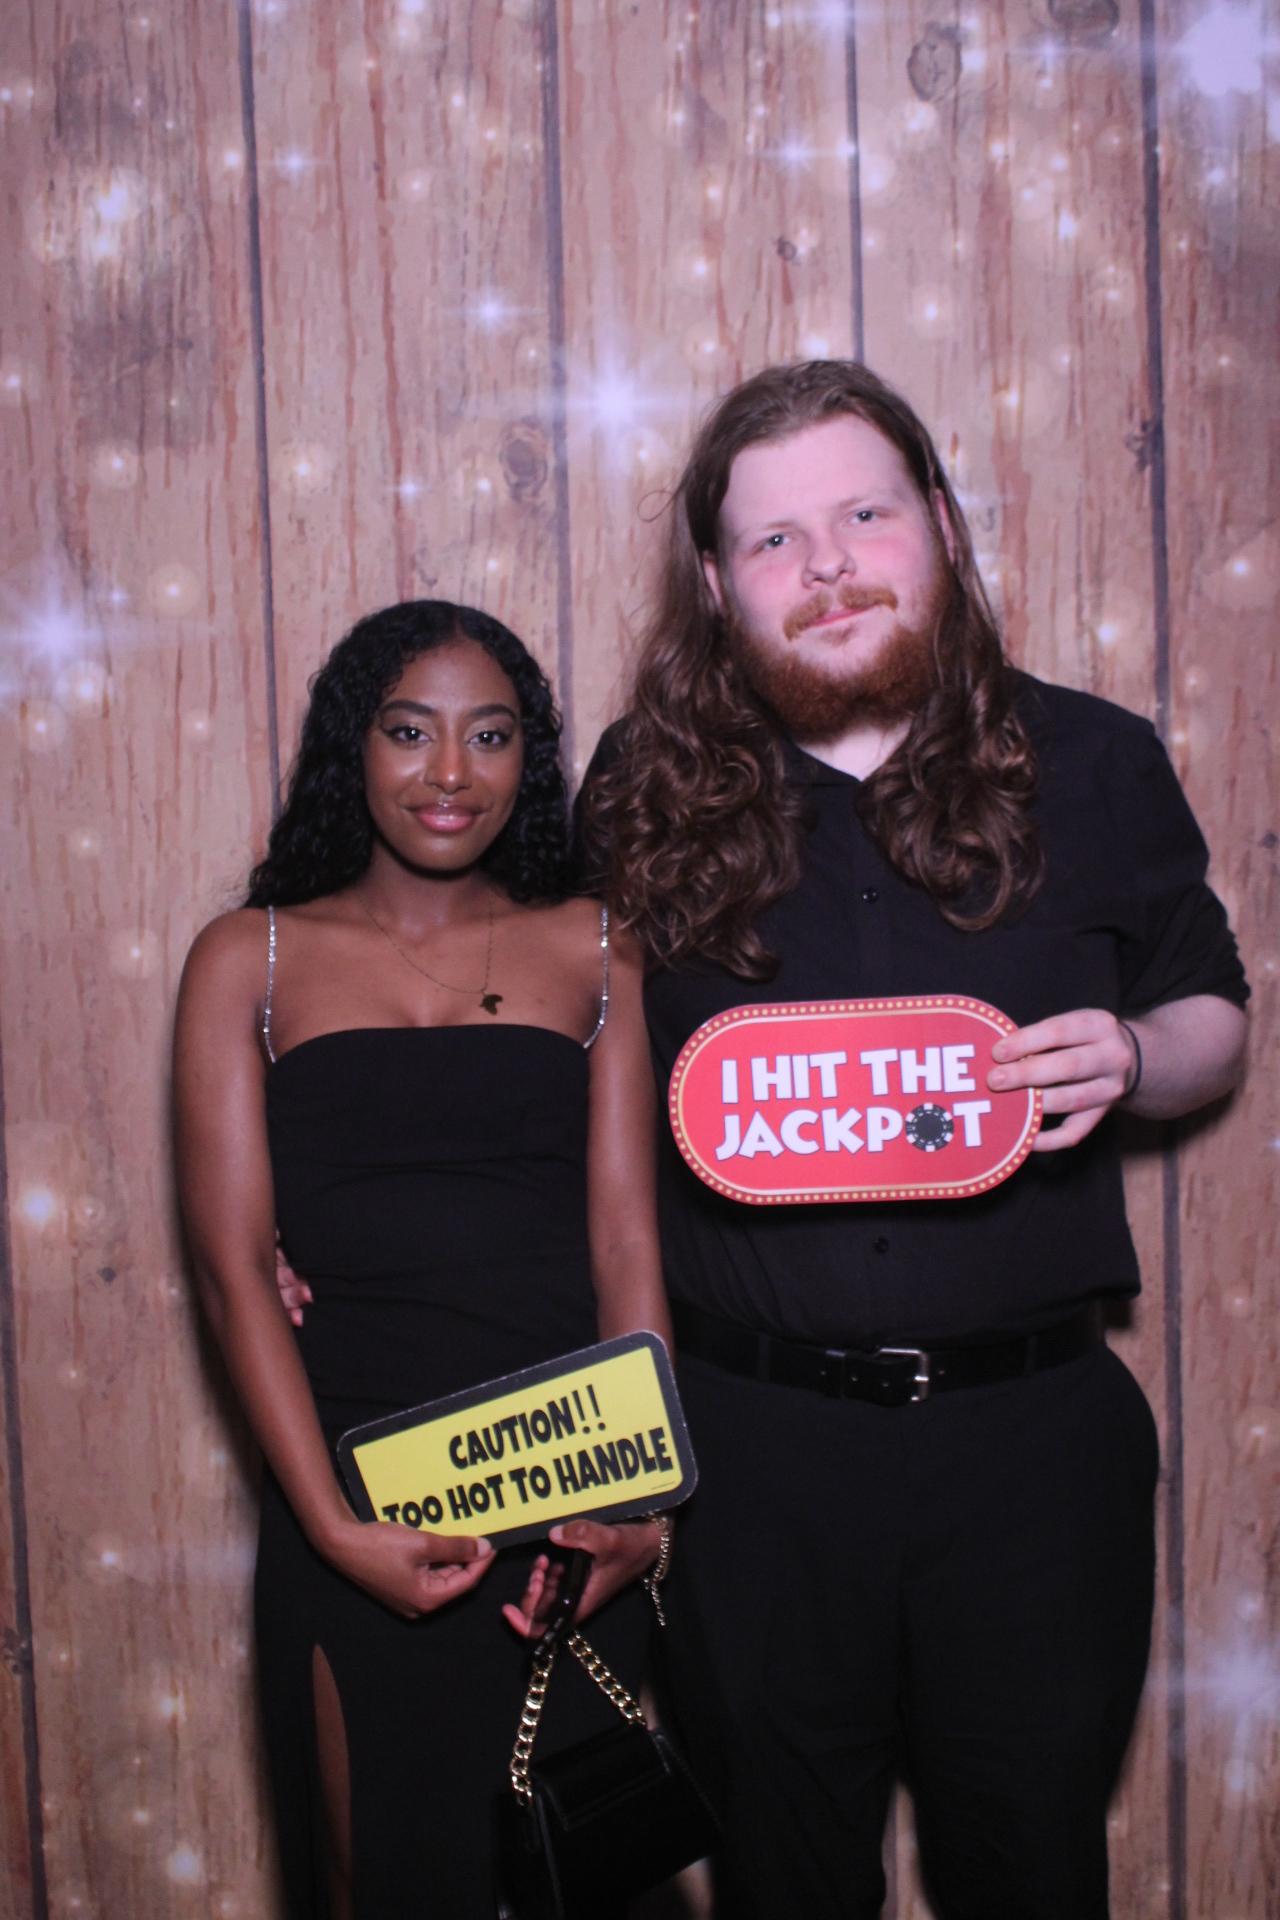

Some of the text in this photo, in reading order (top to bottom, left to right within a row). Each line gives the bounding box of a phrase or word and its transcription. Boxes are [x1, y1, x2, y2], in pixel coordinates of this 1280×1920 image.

[722, 1044, 976, 1103] I HIT THE
[714, 1100, 991, 1161] JACKPOT
[449, 1384, 607, 1470] CAUTION!!
[381, 1427, 673, 1529] TOO HOT TO HANDLE
